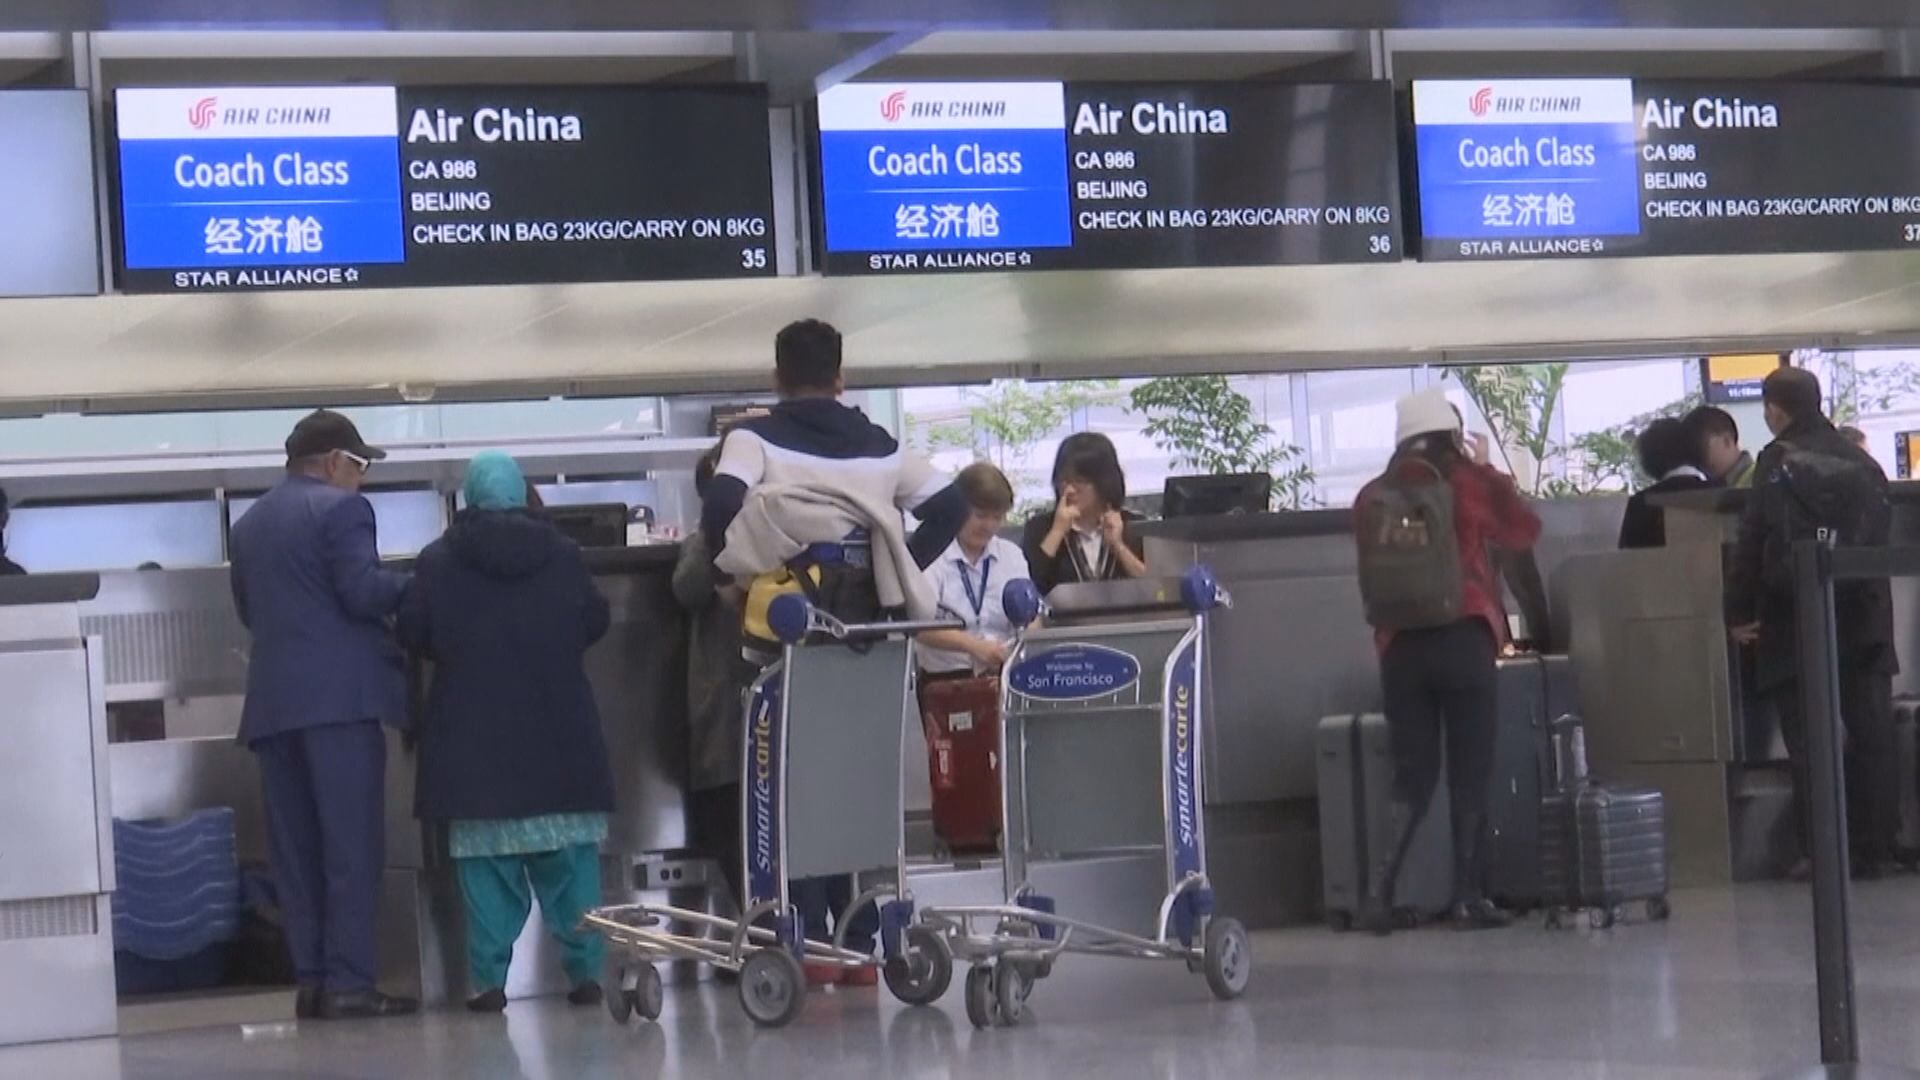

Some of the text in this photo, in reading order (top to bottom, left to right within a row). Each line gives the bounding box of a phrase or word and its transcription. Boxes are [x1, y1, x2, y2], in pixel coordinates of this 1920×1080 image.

[911, 102, 1006, 117] AIR CHINA
[1496, 97, 1581, 112] AIR CHINA
[1642, 98, 1778, 130] Air China
[223, 108, 331, 125] AIR CHINA
[407, 108, 582, 143] Air China
[1073, 102, 1227, 135] Air China
[868, 143, 1023, 177] Coach Class
[1075, 151, 1135, 170] CA 986
[1458, 137, 1596, 168] Coach Class
[1643, 144, 1696, 161] CA 986
[174, 152, 349, 188] Coach Class
[410, 160, 477, 180] CA 986
[1077, 181, 1148, 200] BEIJING
[1643, 172, 1707, 190] BEIJING
[411, 192, 491, 212] BEIJING
[1482, 193, 1576, 227] 经济舱
[1645, 197, 1920, 218] CHECK IN BAG 23KG/CARRY ON 8KG
[895, 202, 1000, 239] 经济舱
[1078, 207, 1390, 230] CHECK IN BAG 23KG/CARRY ON 8KG
[204, 216, 323, 254] 经济舱
[413, 218, 765, 244] CHECK IN BAG 23KG/CARRY ON 8KG
[1369, 236, 1391, 254] 36
[1459, 238, 1591, 256] STAR ALLIANCE
[741, 249, 766, 269] 35
[869, 251, 1018, 270] STAR ALLIANCE
[175, 268, 342, 287] STAR ALLIANCE
[1046, 662, 1082, 671] Welcome
[1027, 671, 1113, 689] San Francisco
[1174, 685, 1193, 847] smartecarte
